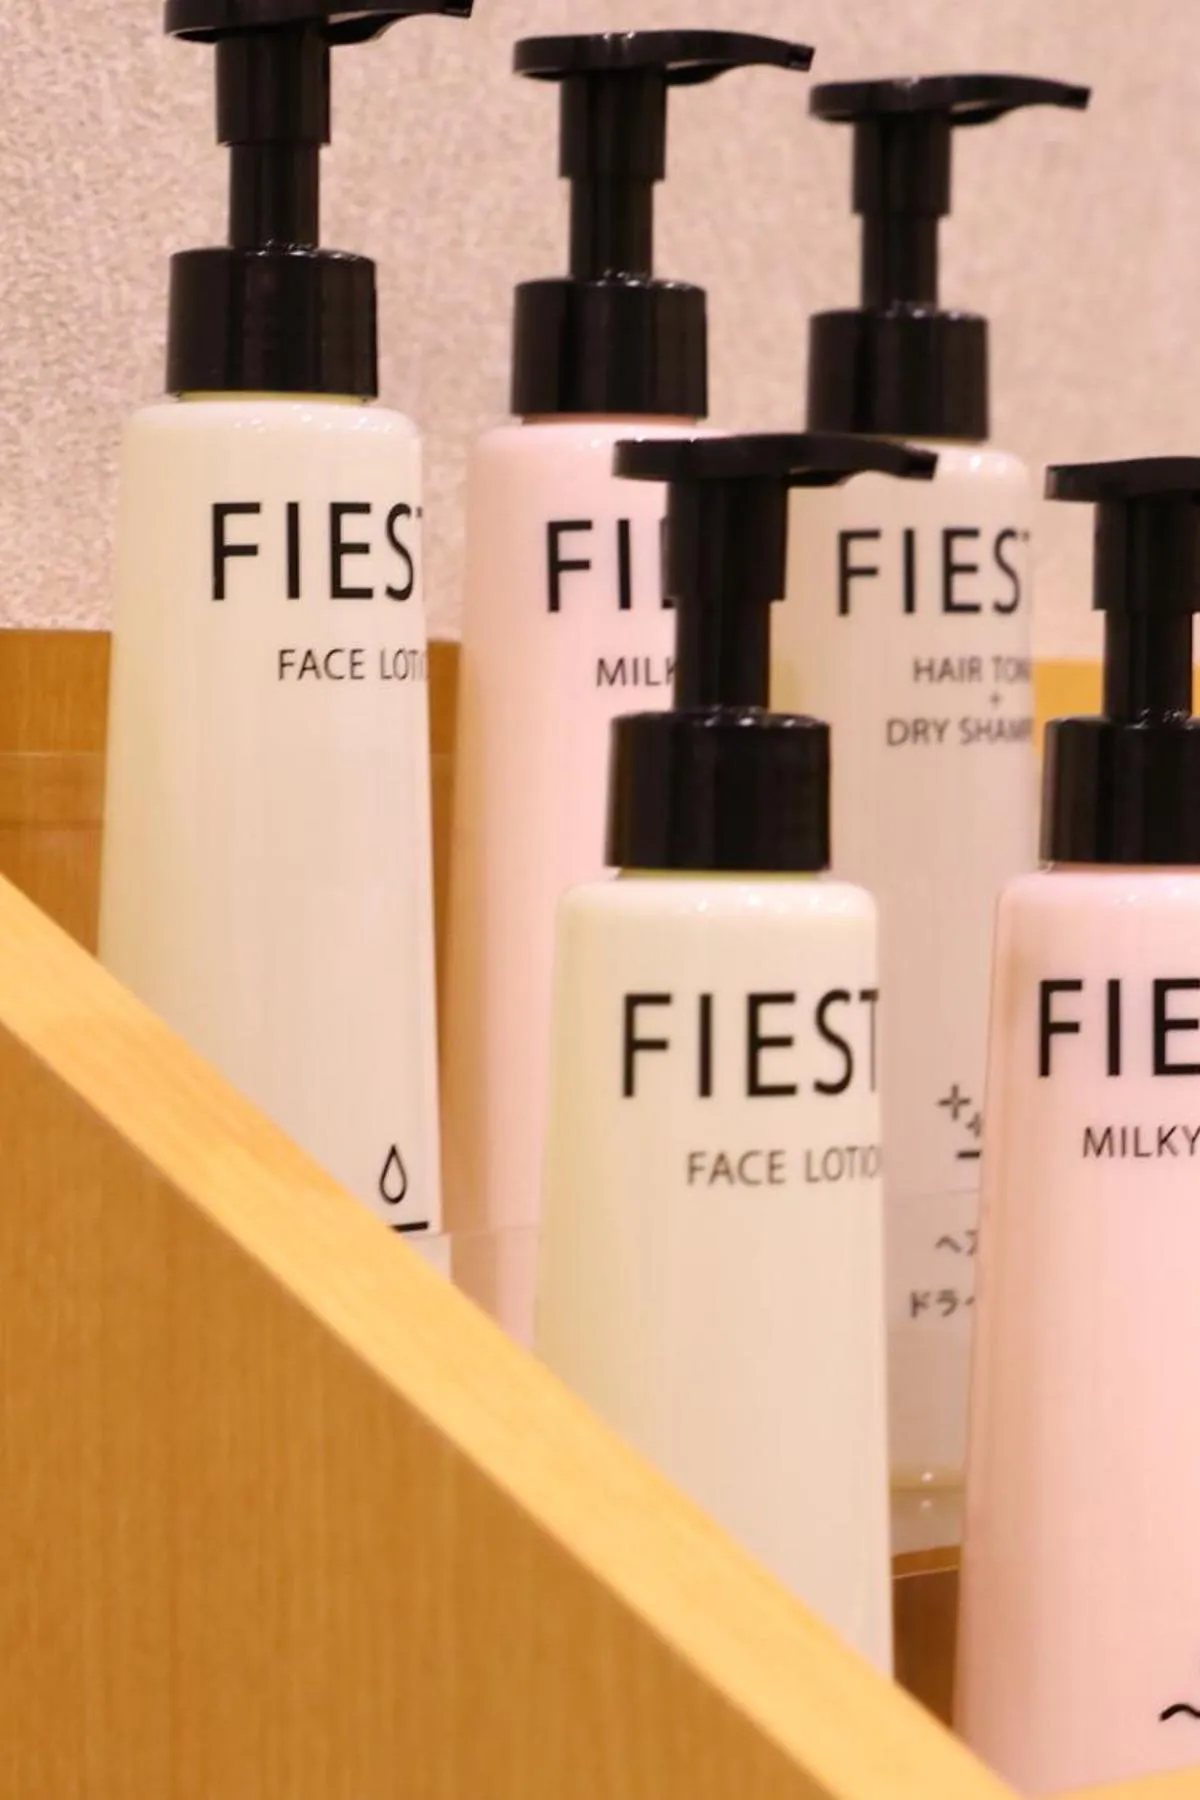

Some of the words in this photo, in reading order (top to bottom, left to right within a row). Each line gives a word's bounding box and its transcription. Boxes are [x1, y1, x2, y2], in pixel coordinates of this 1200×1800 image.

[211, 501, 423, 602] FIES
[838, 527, 1030, 617] FIES
[278, 648, 366, 681] FACE
[912, 656, 983, 684] HAIR
[886, 717, 949, 747] DRY
[623, 988, 879, 1098] FIEST
[687, 1150, 786, 1187] FACE
